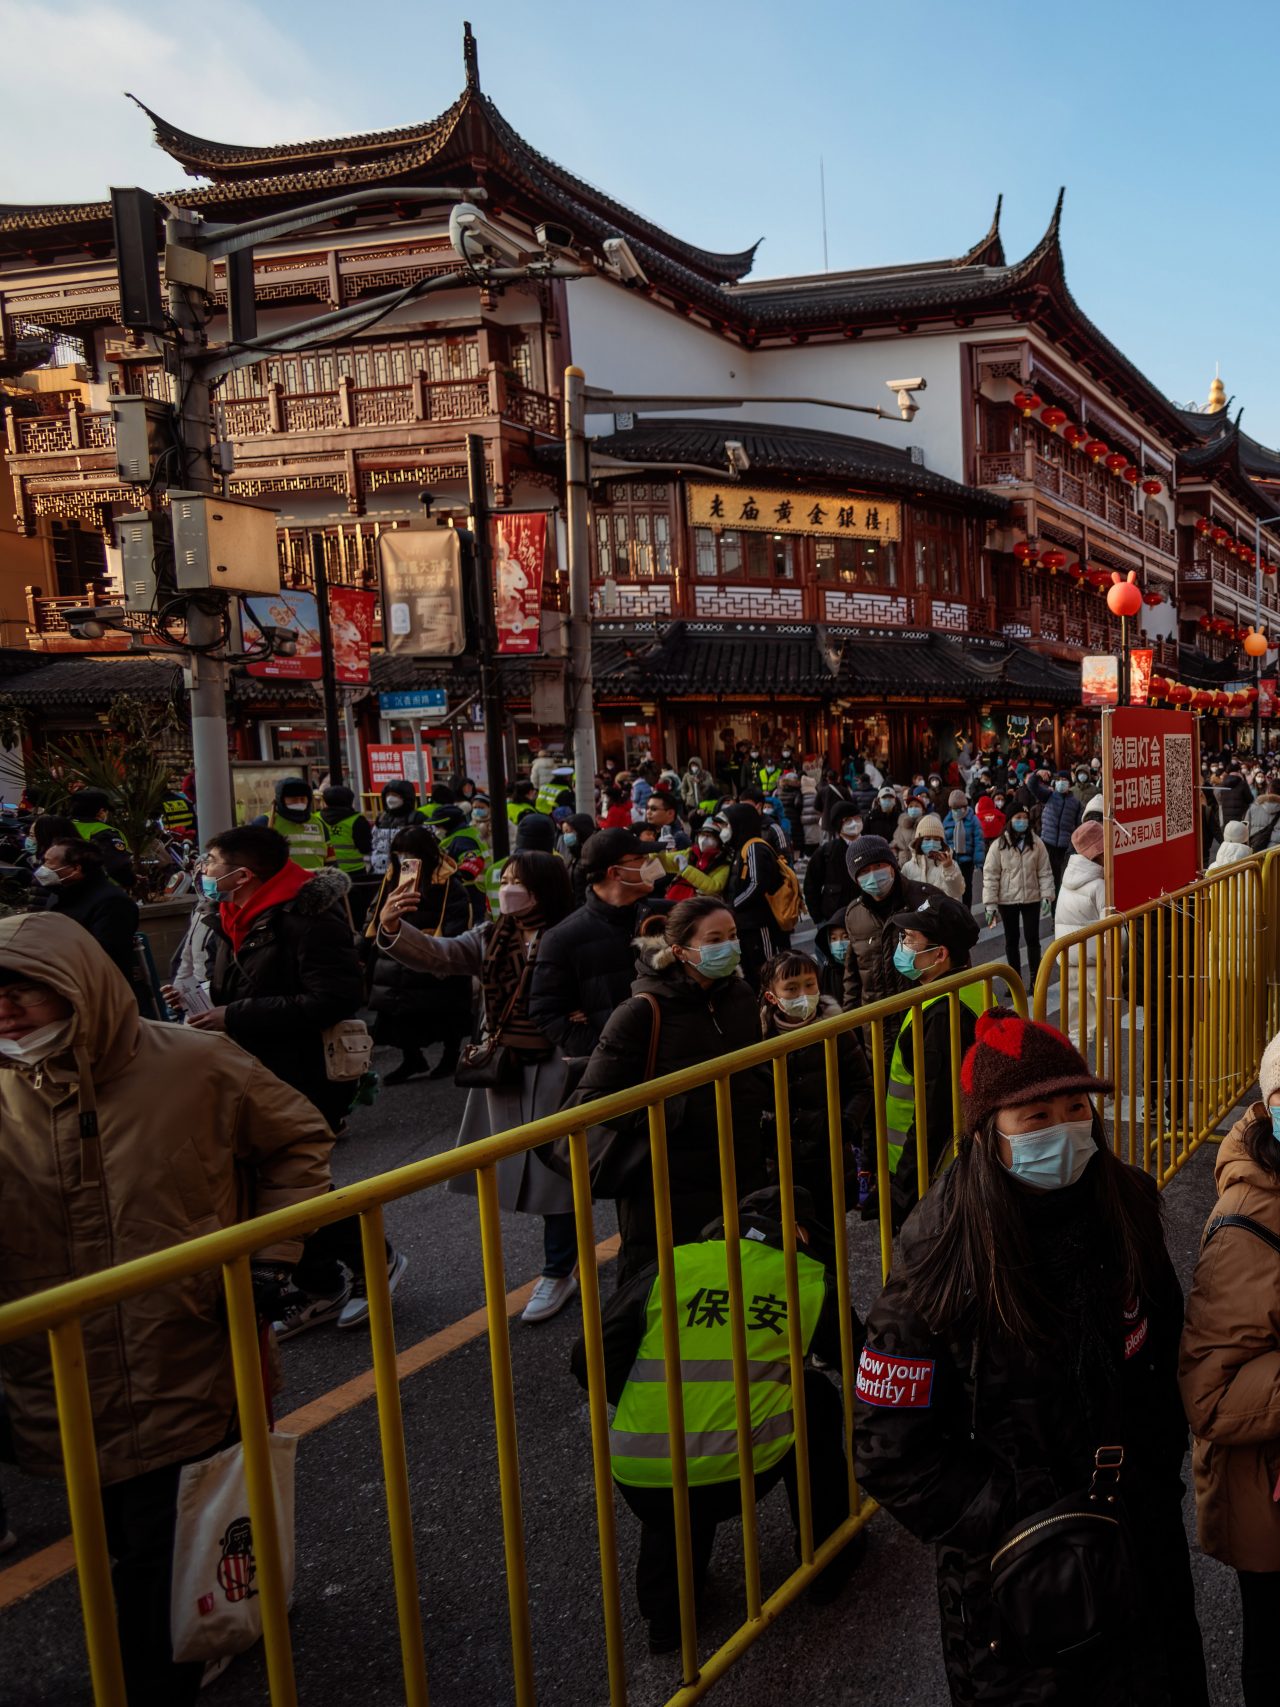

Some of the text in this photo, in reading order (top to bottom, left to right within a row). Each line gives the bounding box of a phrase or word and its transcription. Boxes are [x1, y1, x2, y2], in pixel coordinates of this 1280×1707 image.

[686, 1287, 787, 1335] 保安
[886, 1363, 930, 1381] your
[911, 1382, 916, 1402] !
